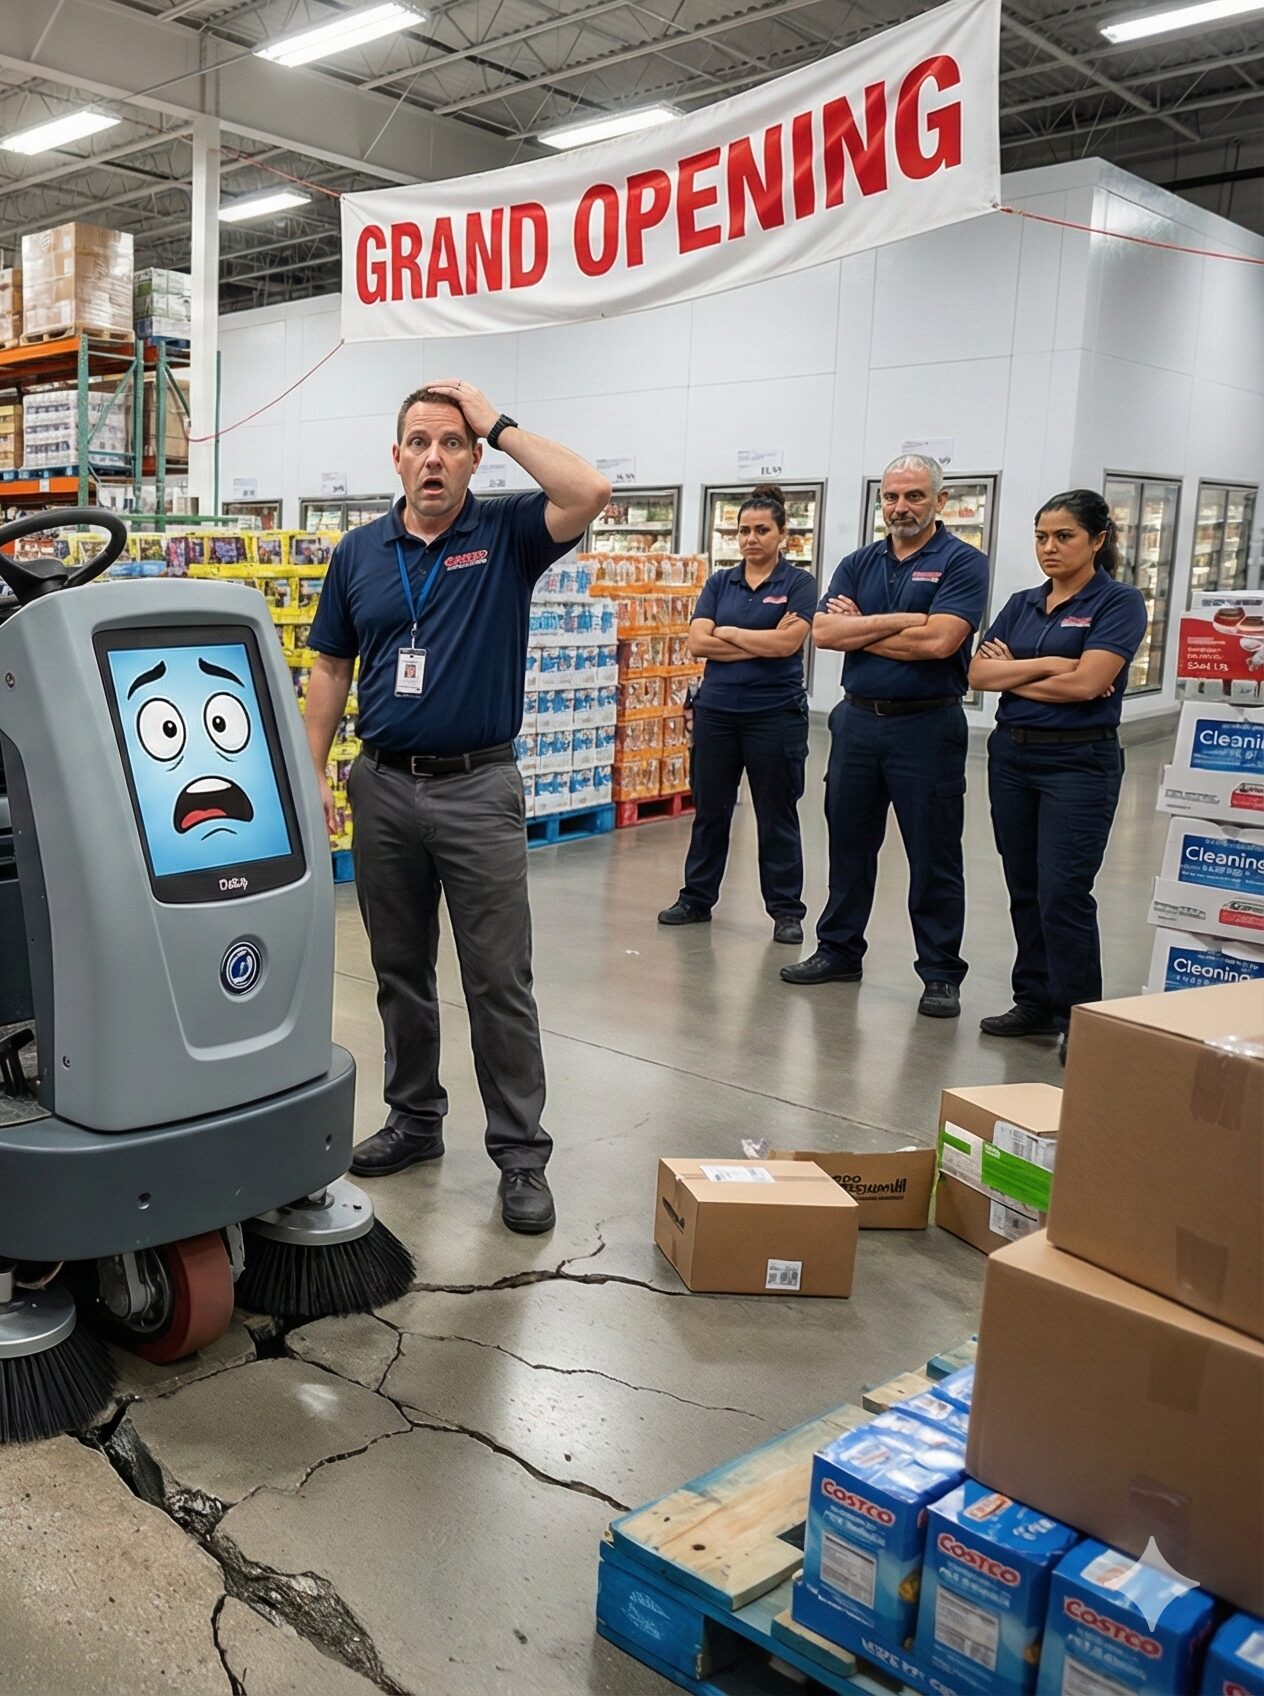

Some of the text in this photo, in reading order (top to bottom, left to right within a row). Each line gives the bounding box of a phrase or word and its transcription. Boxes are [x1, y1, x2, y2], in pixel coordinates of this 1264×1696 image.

[355, 53, 963, 306] GRAND OPENING
[823, 1480, 894, 1525] COSTCO
[938, 1534, 1019, 1585] COSTCO
[1065, 1599, 1162, 1657] COSTCO
